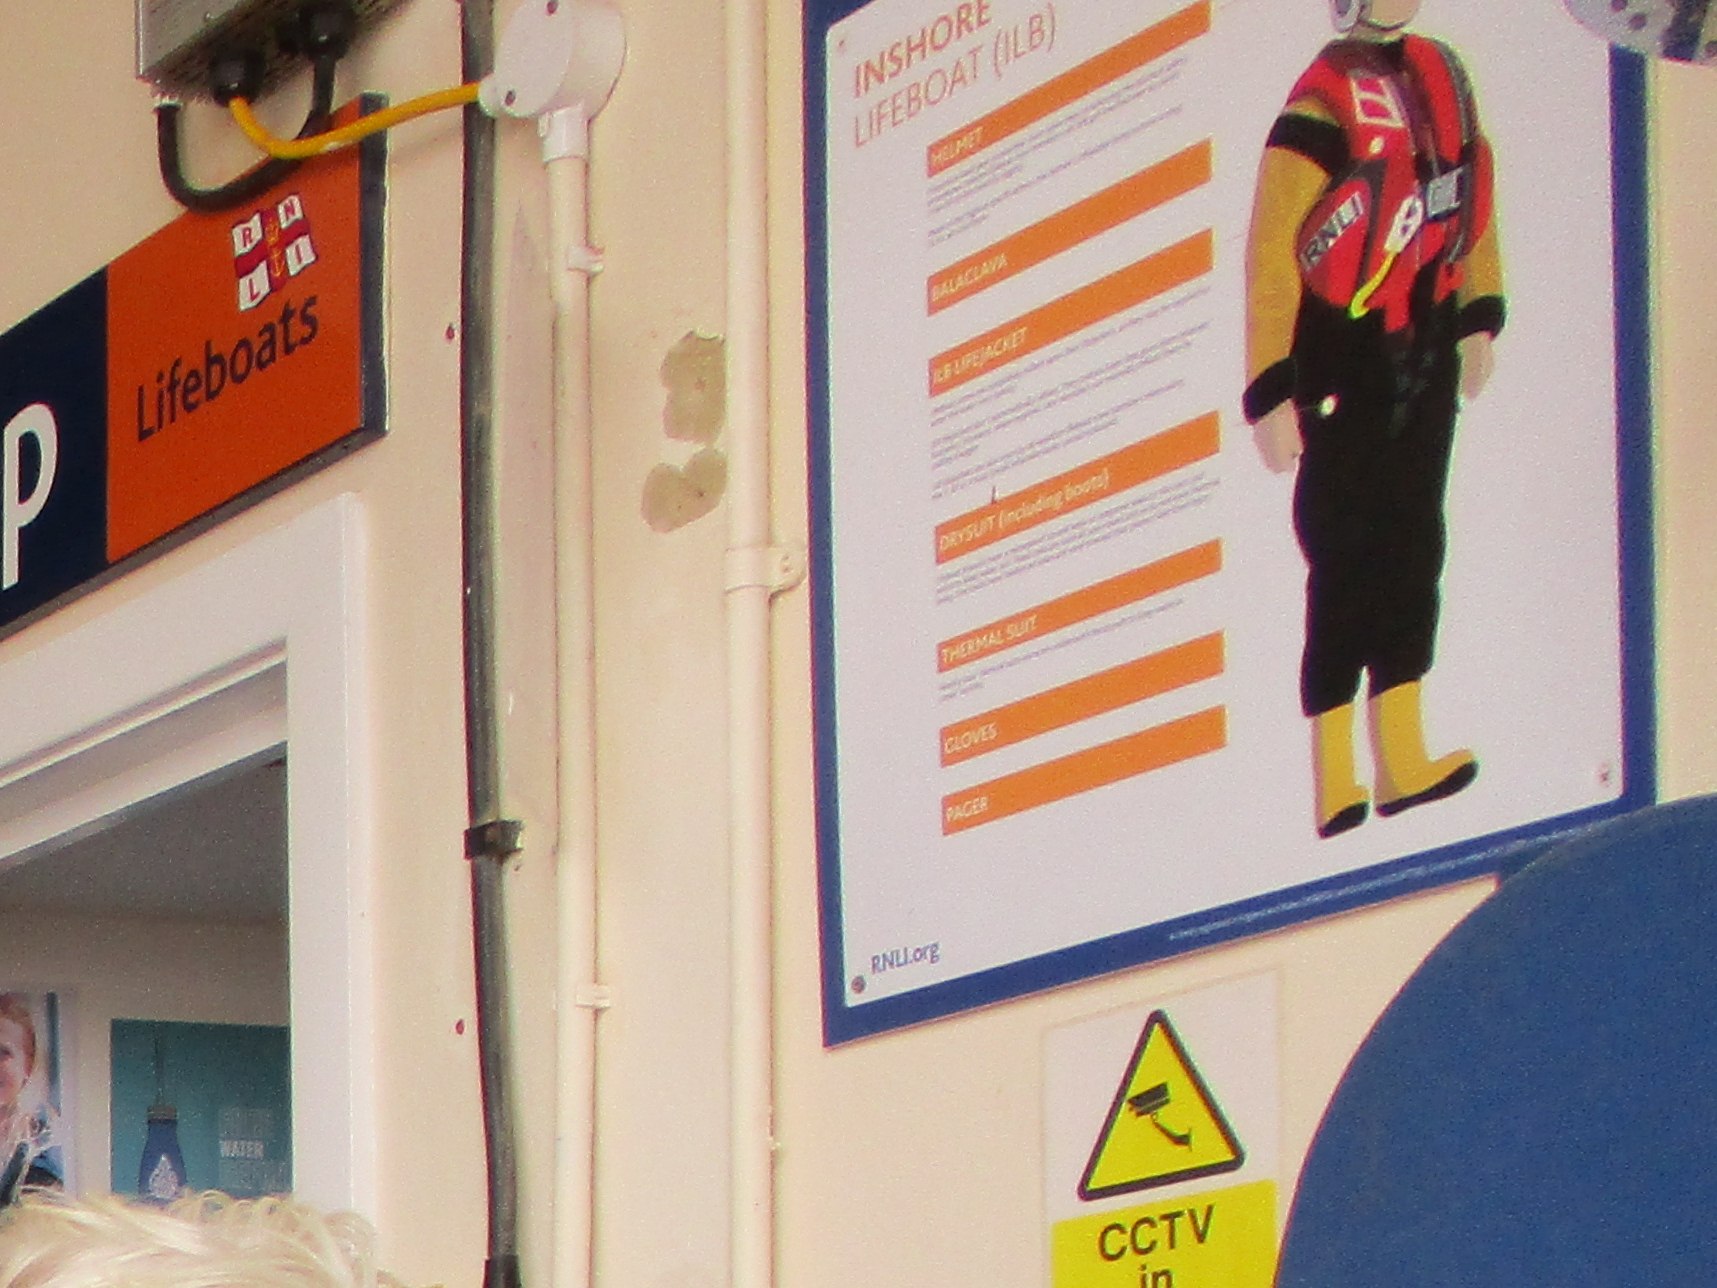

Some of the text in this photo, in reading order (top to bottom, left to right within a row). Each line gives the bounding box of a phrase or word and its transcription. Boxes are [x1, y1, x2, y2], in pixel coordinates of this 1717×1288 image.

[855, 0, 992, 98] INSHORE
[855, 6, 1056, 148] LIFEBOAT (ILB)
[137, 295, 320, 443] Lifeboats
[871, 940, 940, 975] RNLI.org
[1098, 1204, 1217, 1262] CCTV
